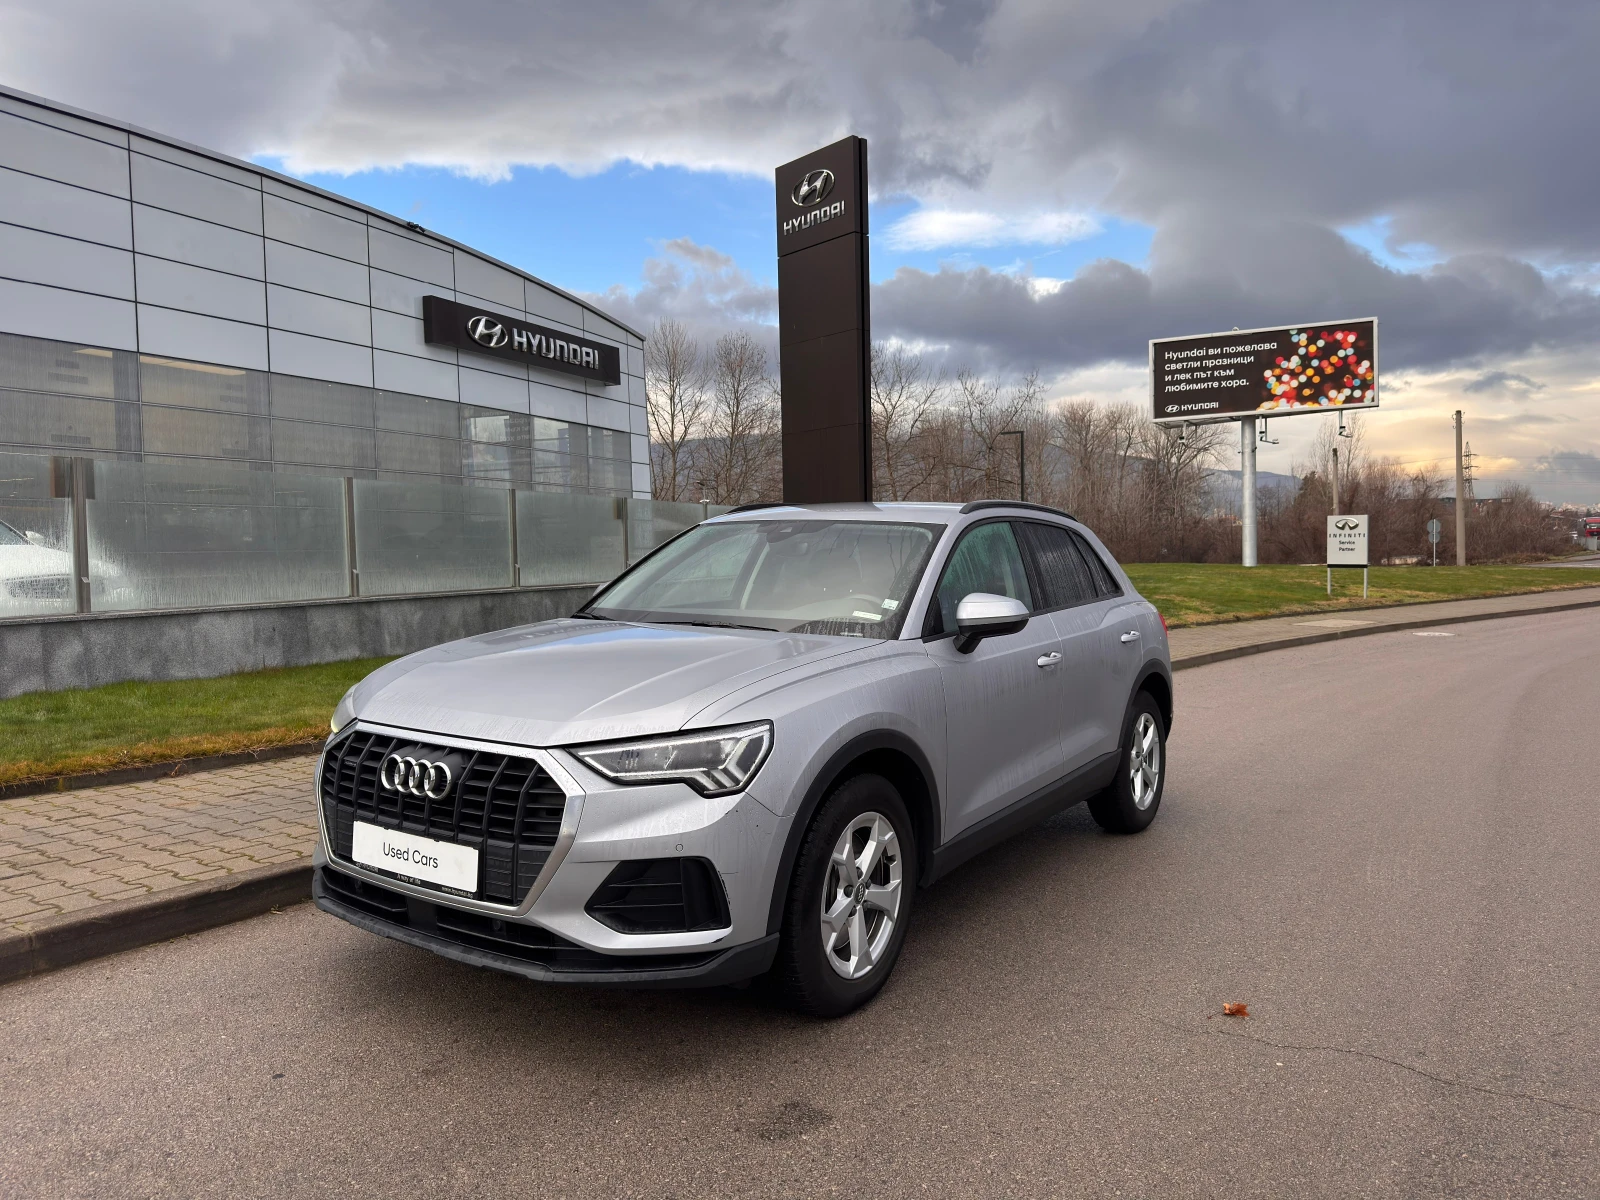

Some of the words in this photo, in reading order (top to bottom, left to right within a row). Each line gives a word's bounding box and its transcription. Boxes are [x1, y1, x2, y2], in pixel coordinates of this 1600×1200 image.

[783, 200, 845, 235] HYUNDAI
[511, 327, 599, 370] HYUNDAI
[1164, 347, 1206, 360] Hyundai
[1208, 347, 1221, 356] ви
[1223, 342, 1277, 354] пожелава
[1164, 360, 1201, 371] светли
[1202, 355, 1254, 368] празници
[1164, 374, 1172, 382] и
[1173, 372, 1192, 381] лек
[1193, 370, 1212, 379] път
[1213, 369, 1235, 377] към
[1164, 381, 1219, 393] любимите
[1220, 378, 1250, 388] хора.
[1181, 401, 1219, 411] HYUNDAI
[382, 842, 409, 862] Used
[411, 849, 439, 869] Cars
